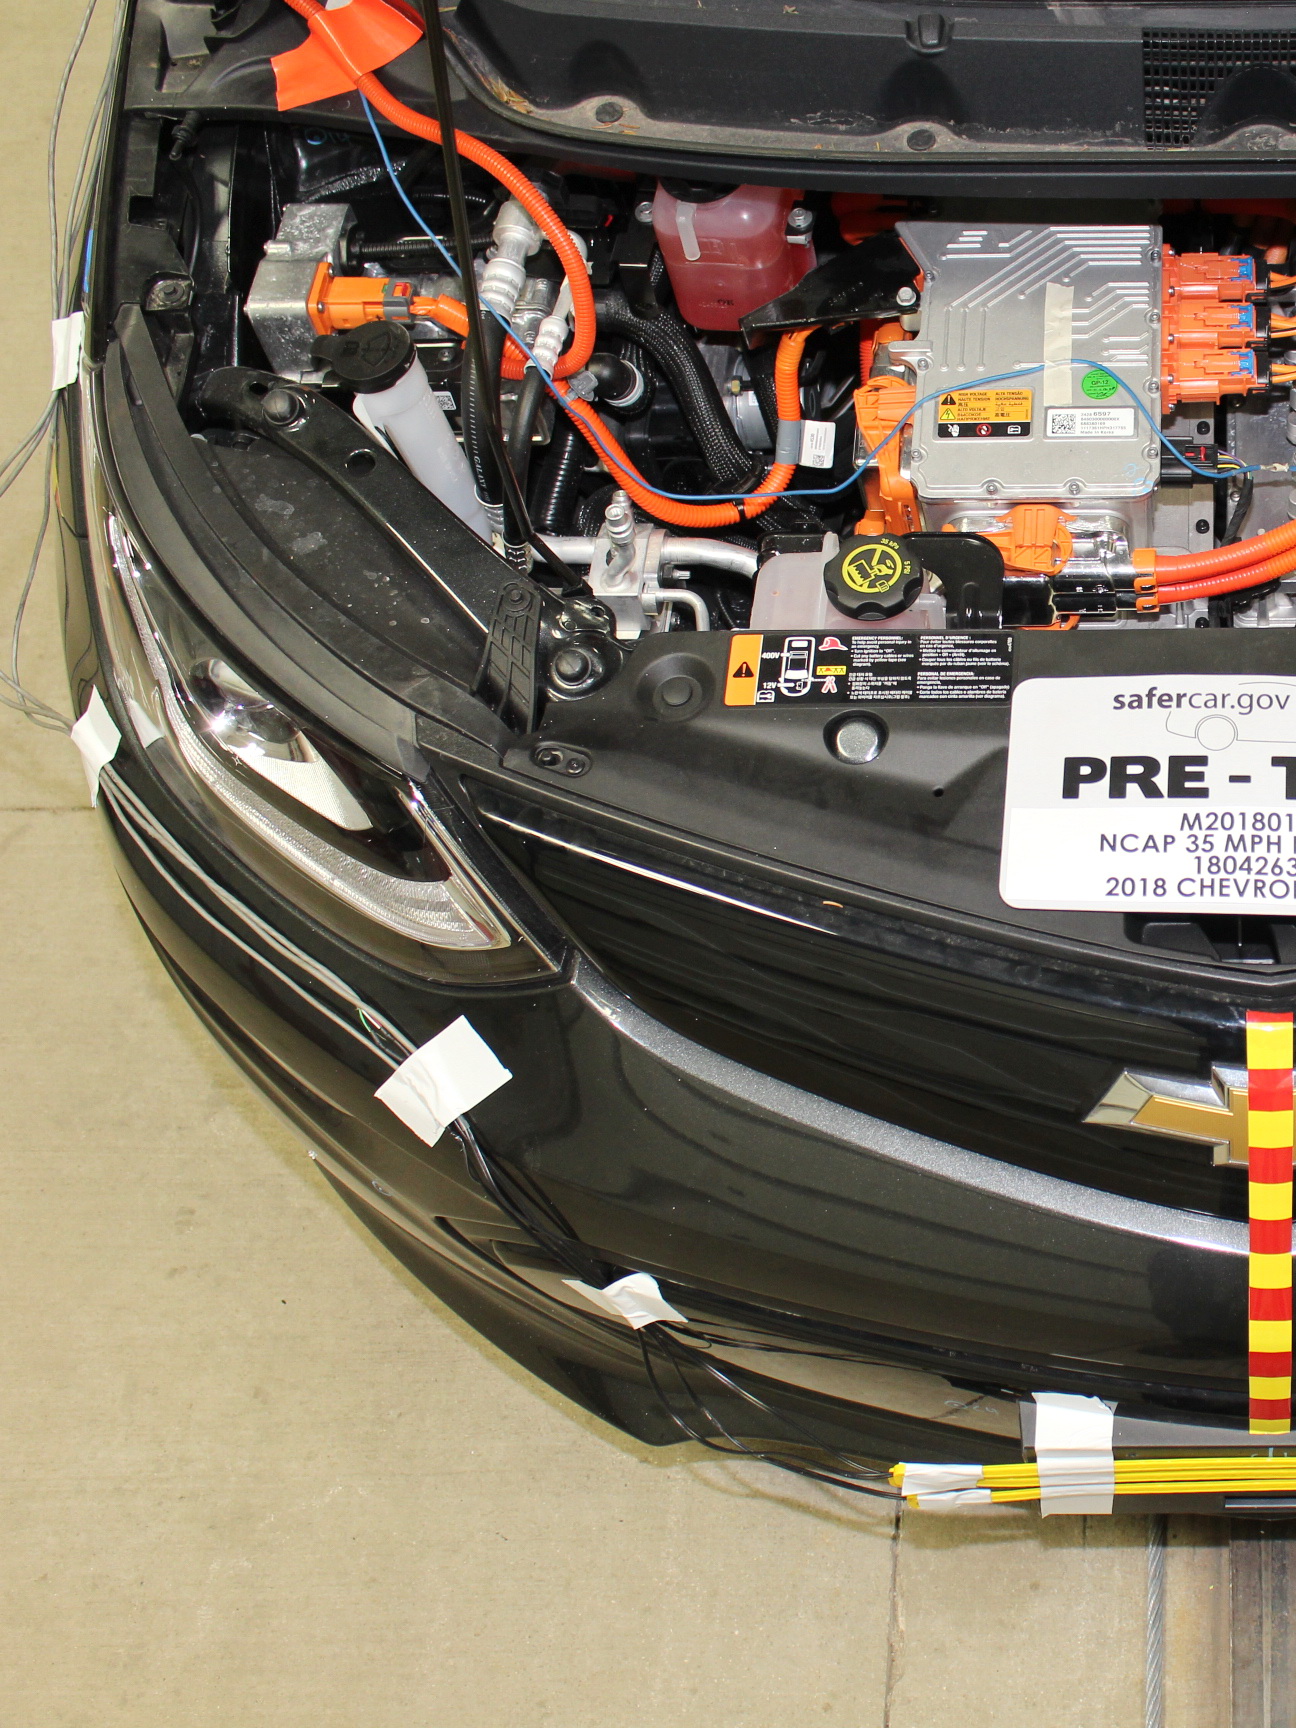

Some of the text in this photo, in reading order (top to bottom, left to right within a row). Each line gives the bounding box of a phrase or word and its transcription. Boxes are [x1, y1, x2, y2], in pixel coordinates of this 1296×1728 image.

[889, 541, 899, 549] kPa
[1112, 687, 1290, 714] safercar.gov
[1062, 755, 1210, 800] PRE
[1228, 774, 1252, 783] -
[1100, 834, 1176, 853] NCAP
[1185, 834, 1214, 853] 35
[1224, 834, 1282, 854] MPH
[1105, 878, 1167, 897] 2018
